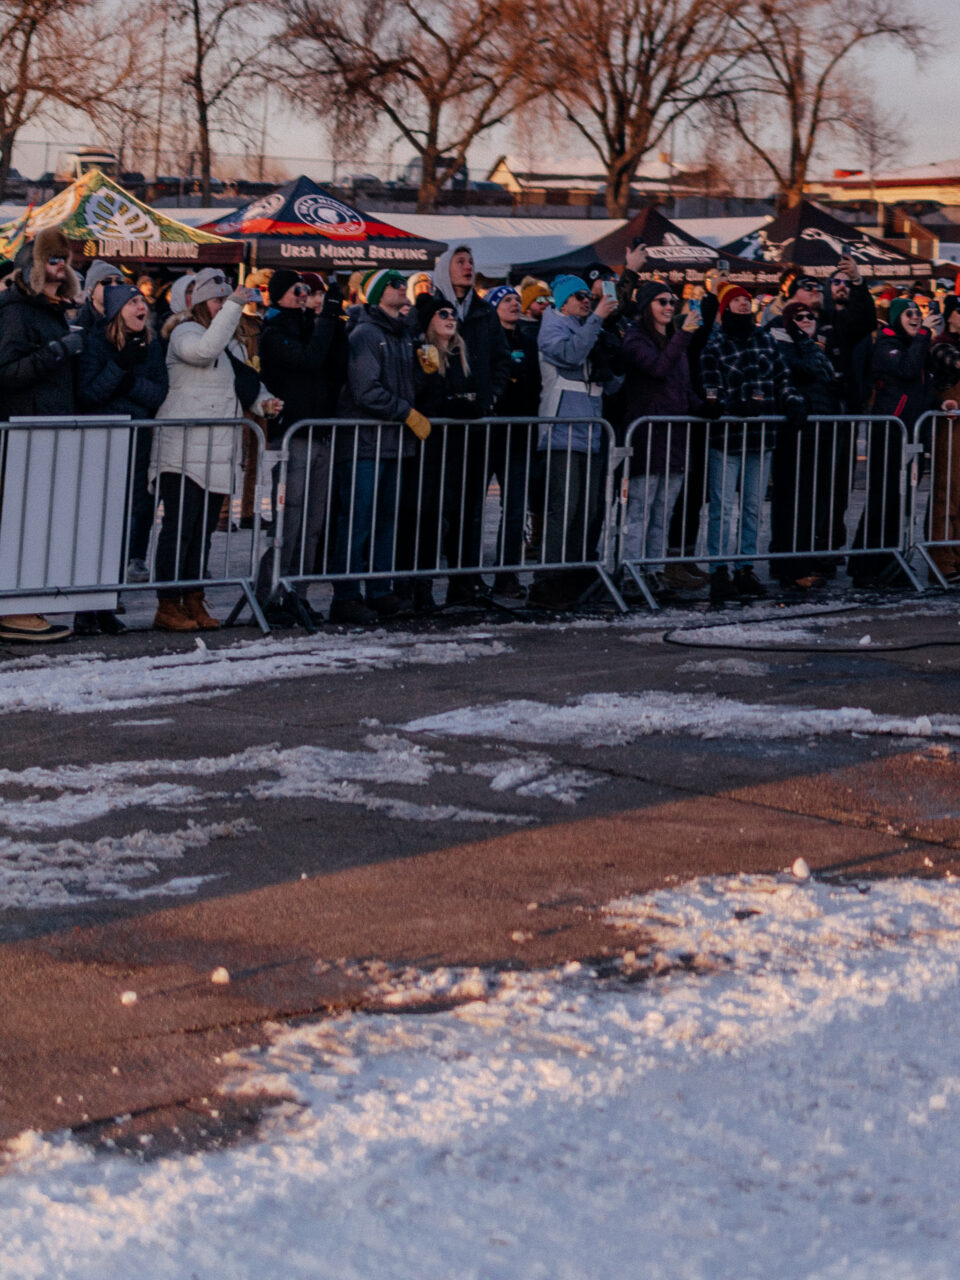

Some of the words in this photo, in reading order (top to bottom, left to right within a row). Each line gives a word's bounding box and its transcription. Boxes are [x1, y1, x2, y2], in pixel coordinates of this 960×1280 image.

[280, 243, 317, 258] URSA
[319, 243, 366, 259] MINOR
[368, 244, 429, 261] BREWING
